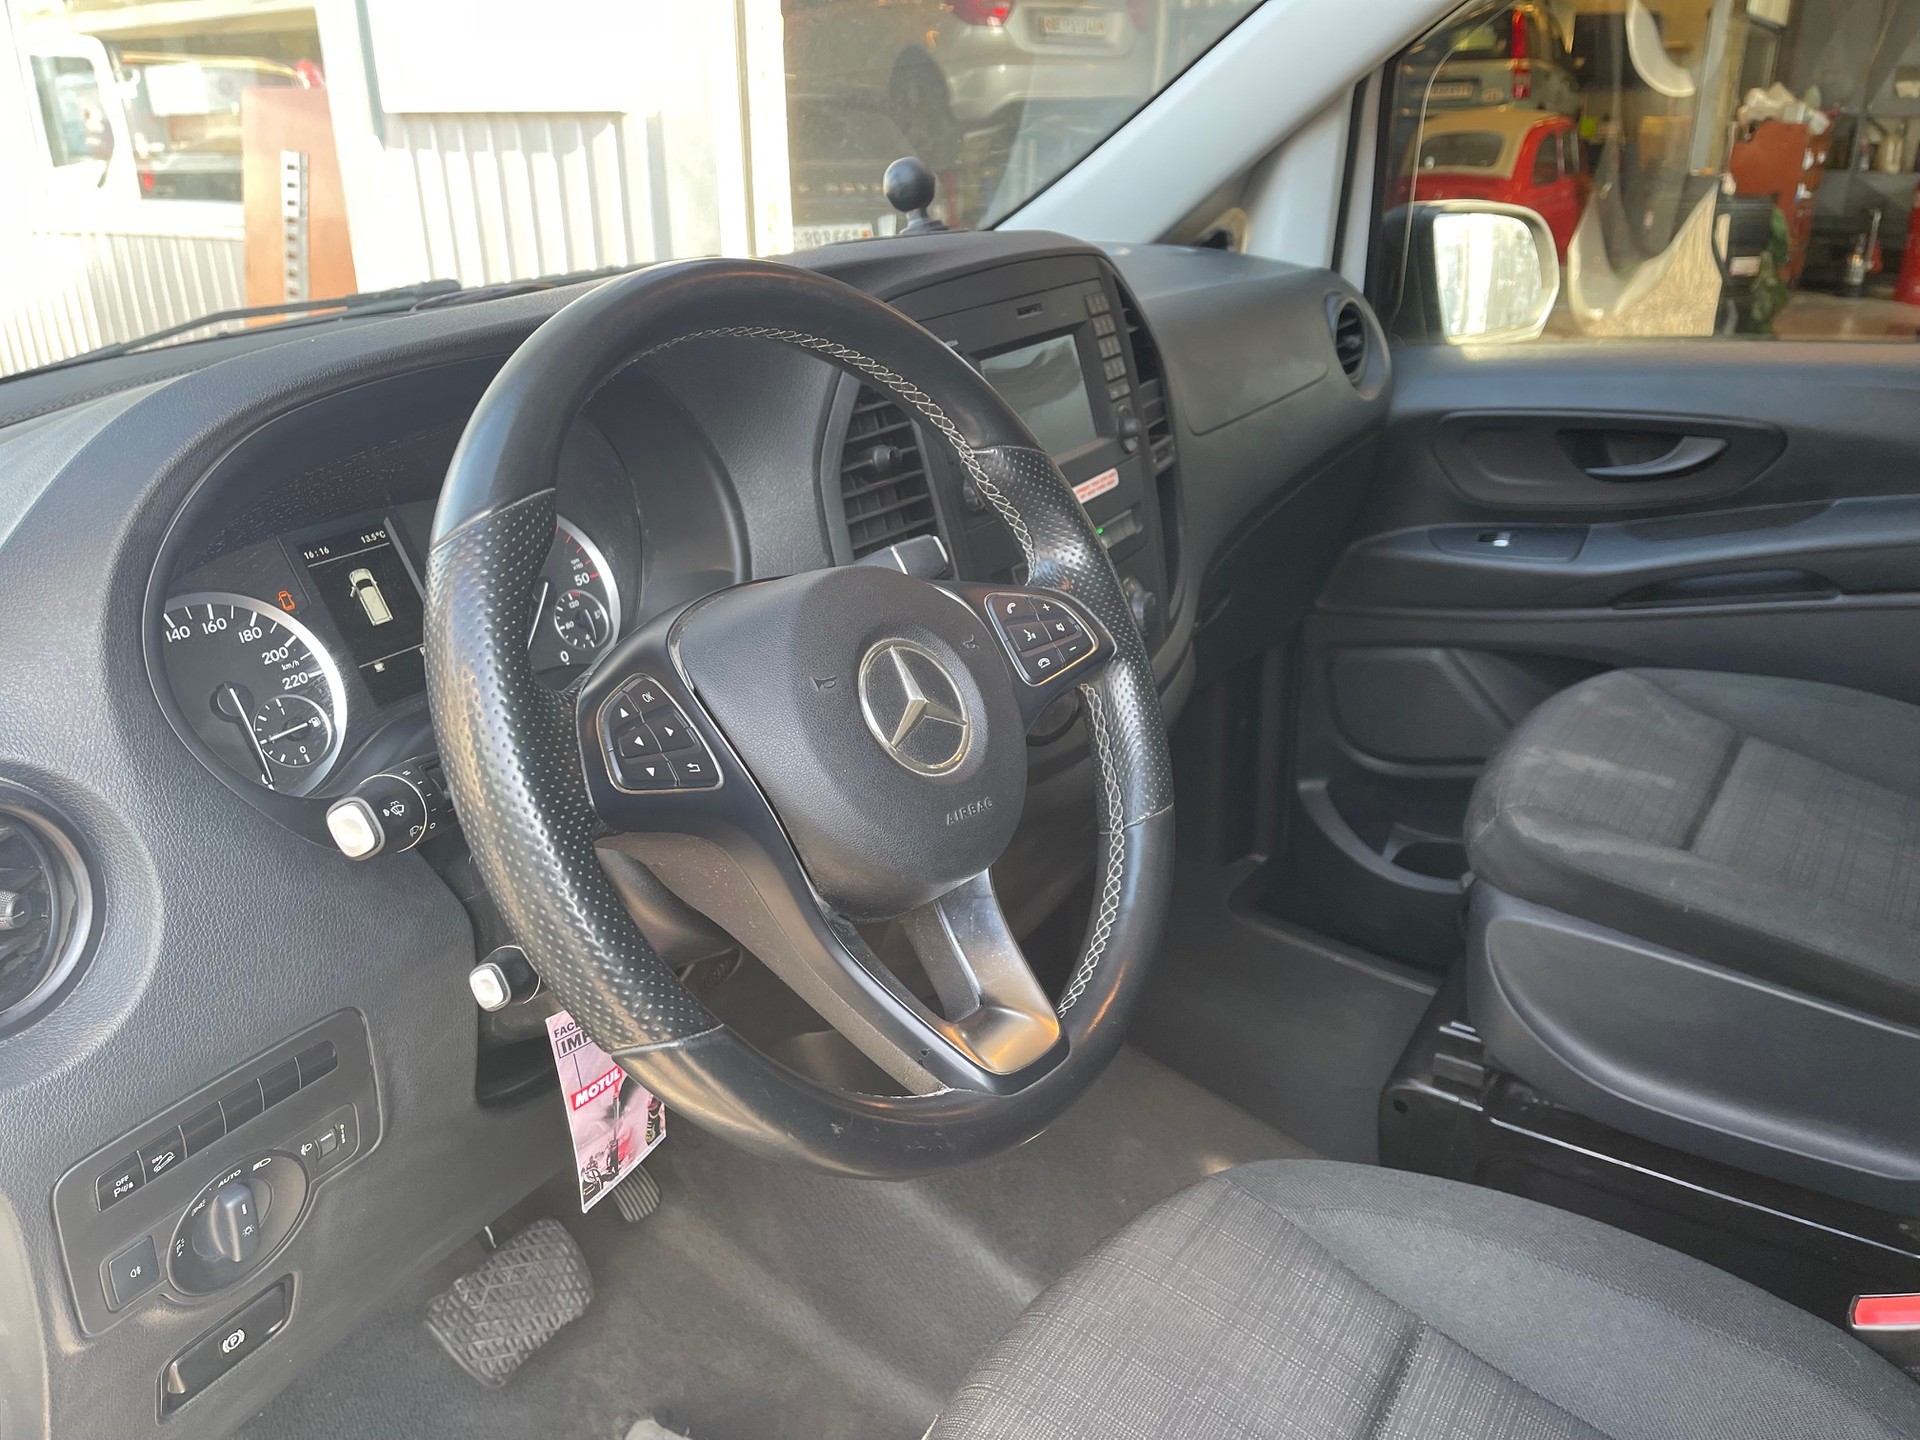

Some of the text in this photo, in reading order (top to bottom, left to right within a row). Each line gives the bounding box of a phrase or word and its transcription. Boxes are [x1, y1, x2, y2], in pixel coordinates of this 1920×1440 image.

[360, 530, 386, 544] 13.5°C
[303, 546, 330, 560] 16:16
[574, 572, 590, 587] 50
[165, 625, 191, 643] 140
[202, 617, 227, 635] 160
[238, 626, 263, 644] 180
[261, 646, 289, 665] 200
[560, 650, 570, 663] 0
[281, 659, 300, 671] km/h
[282, 671, 309, 691] 220
[641, 691, 655, 703] OK
[299, 745, 307, 754] 0
[946, 796, 993, 827] AIRBAG
[553, 1021, 580, 1039] FAC
[574, 1067, 621, 1108] MOTUL
[115, 1174, 130, 1187] OFF
[218, 1169, 242, 1188] AUTO
